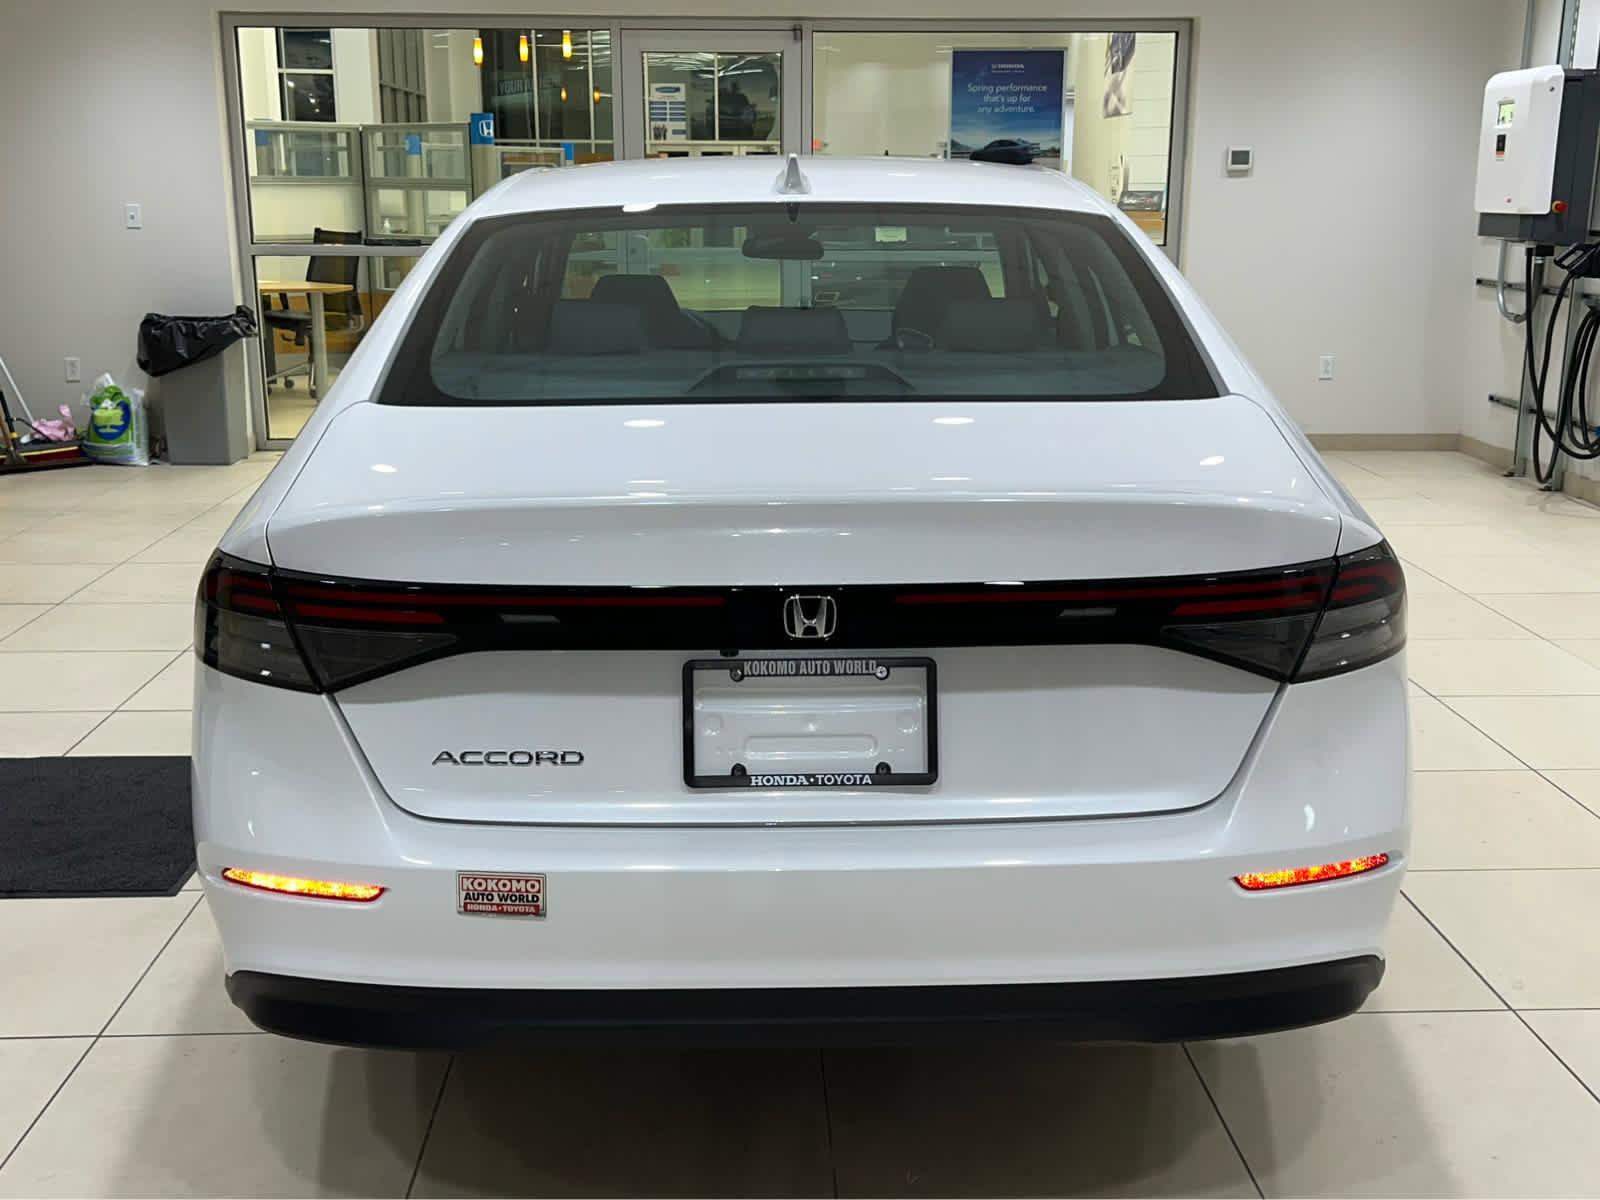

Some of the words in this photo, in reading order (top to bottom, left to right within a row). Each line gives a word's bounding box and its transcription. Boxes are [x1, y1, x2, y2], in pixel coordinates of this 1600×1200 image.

[968, 82, 994, 94] Spring
[996, 82, 1047, 94] performance
[984, 94, 1004, 103] that's
[1007, 96, 1017, 104] up
[1019, 94, 1032, 103] for
[743, 661, 796, 675] KOKOMO
[800, 661, 831, 674] AUTO
[834, 660, 877, 674] WORLD
[432, 751, 585, 766] ACCORD
[750, 775, 810, 786] HONDA
[816, 774, 872, 785] TOYOTA
[462, 877, 540, 892] KOKOMO
[464, 892, 494, 902] AUTO
[498, 893, 540, 904] WORLD
[467, 903, 498, 912] HONDA
[503, 905, 536, 913] TOYOTA
